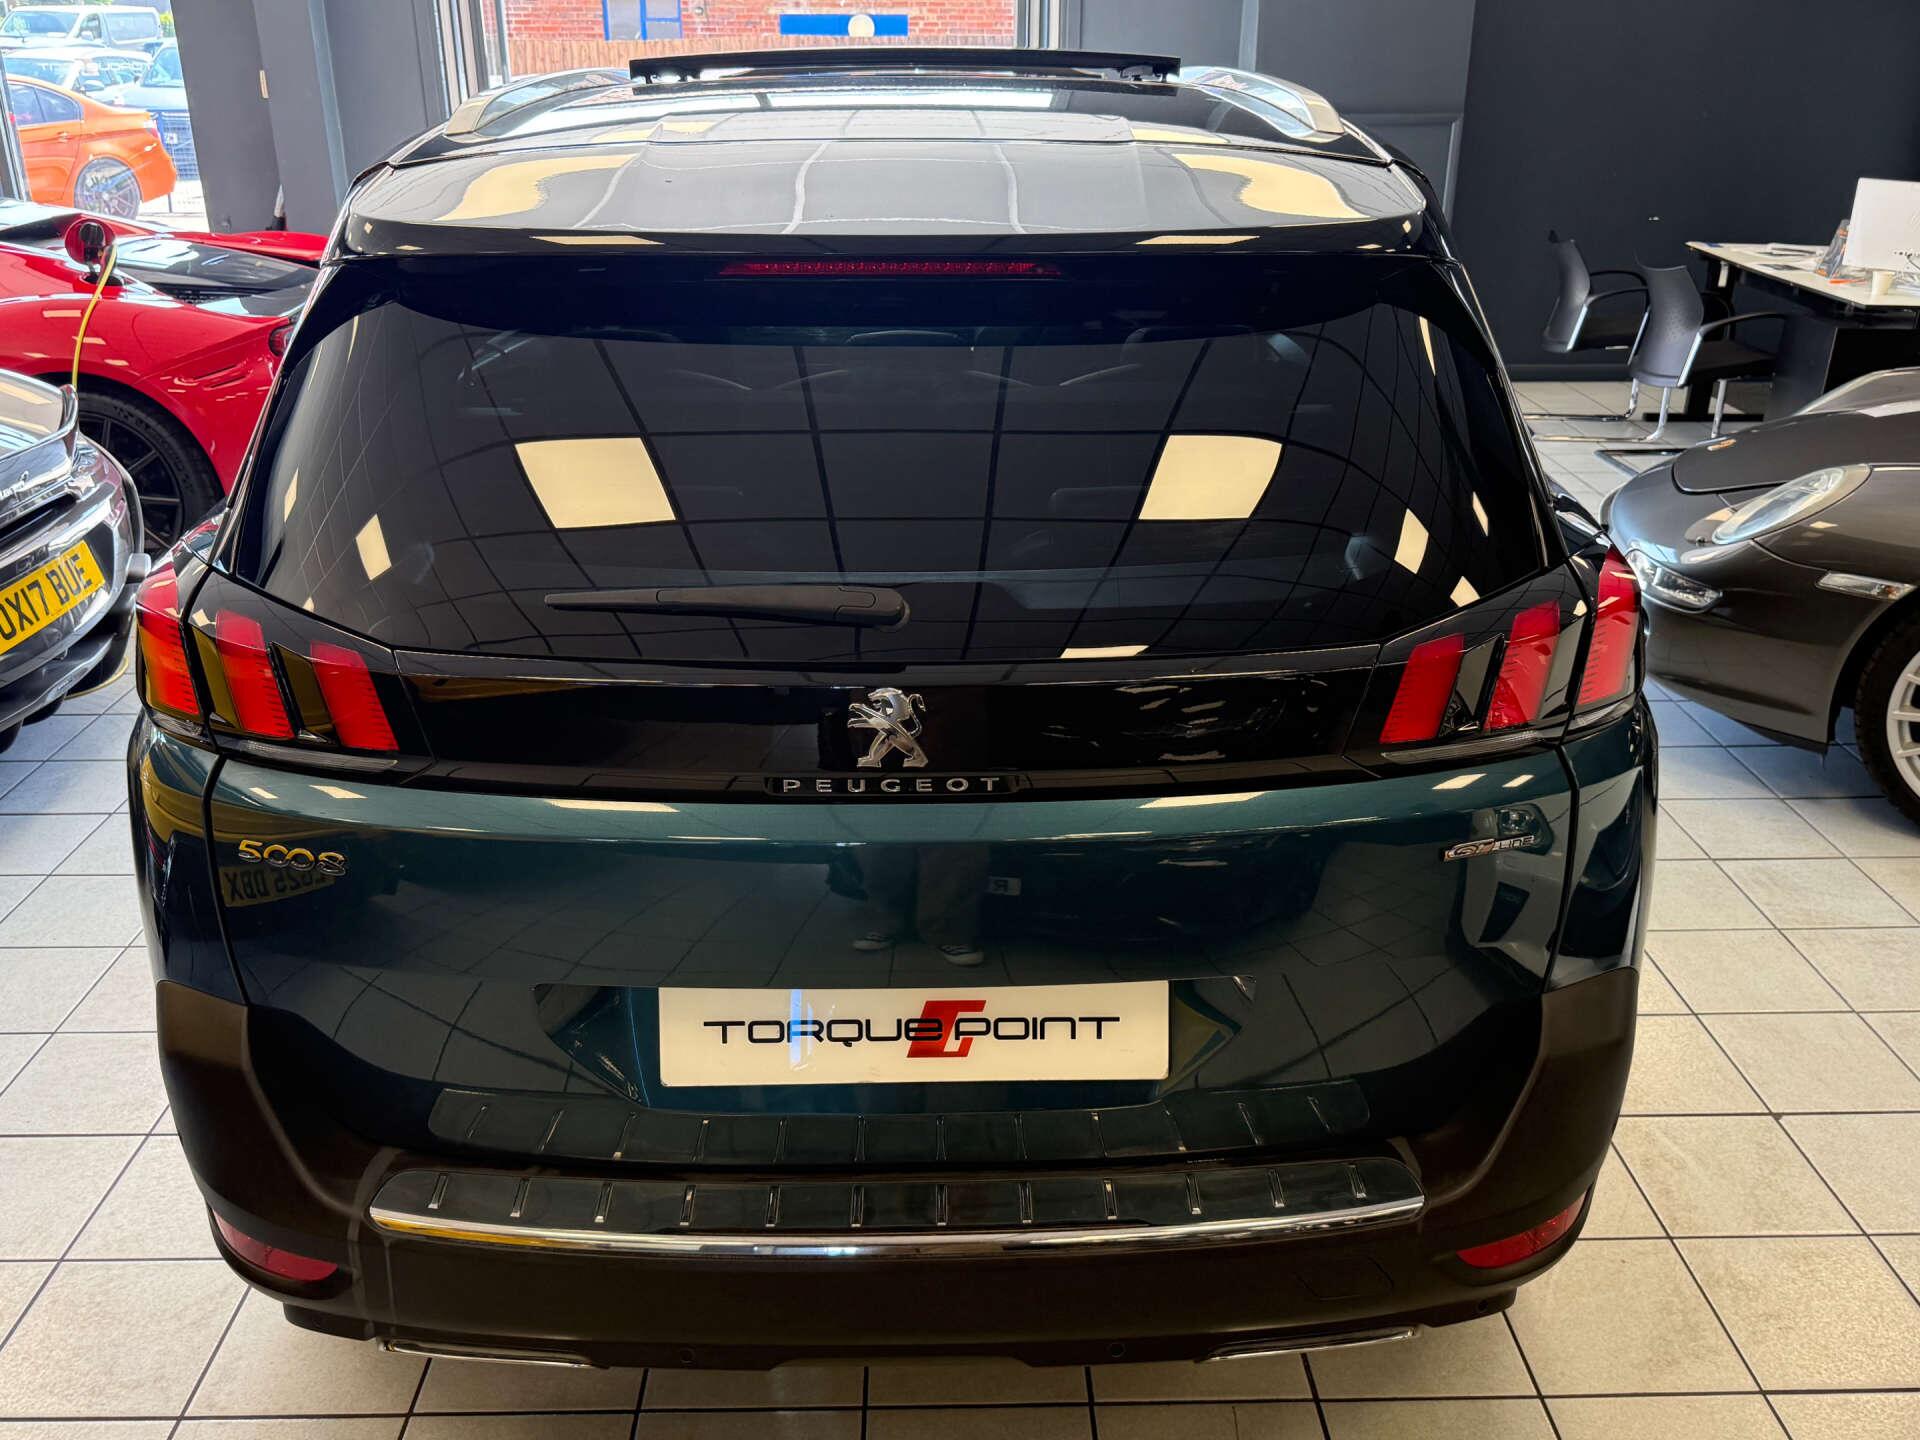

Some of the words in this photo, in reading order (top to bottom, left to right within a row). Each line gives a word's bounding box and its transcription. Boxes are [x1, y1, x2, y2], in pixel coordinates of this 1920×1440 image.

[46, 553, 93, 606] BUE
[783, 778, 999, 793] PEUGEOT
[239, 840, 346, 876] 5008
[703, 1019, 943, 1047] TORQUE
[954, 1016, 1120, 1041] POINT
